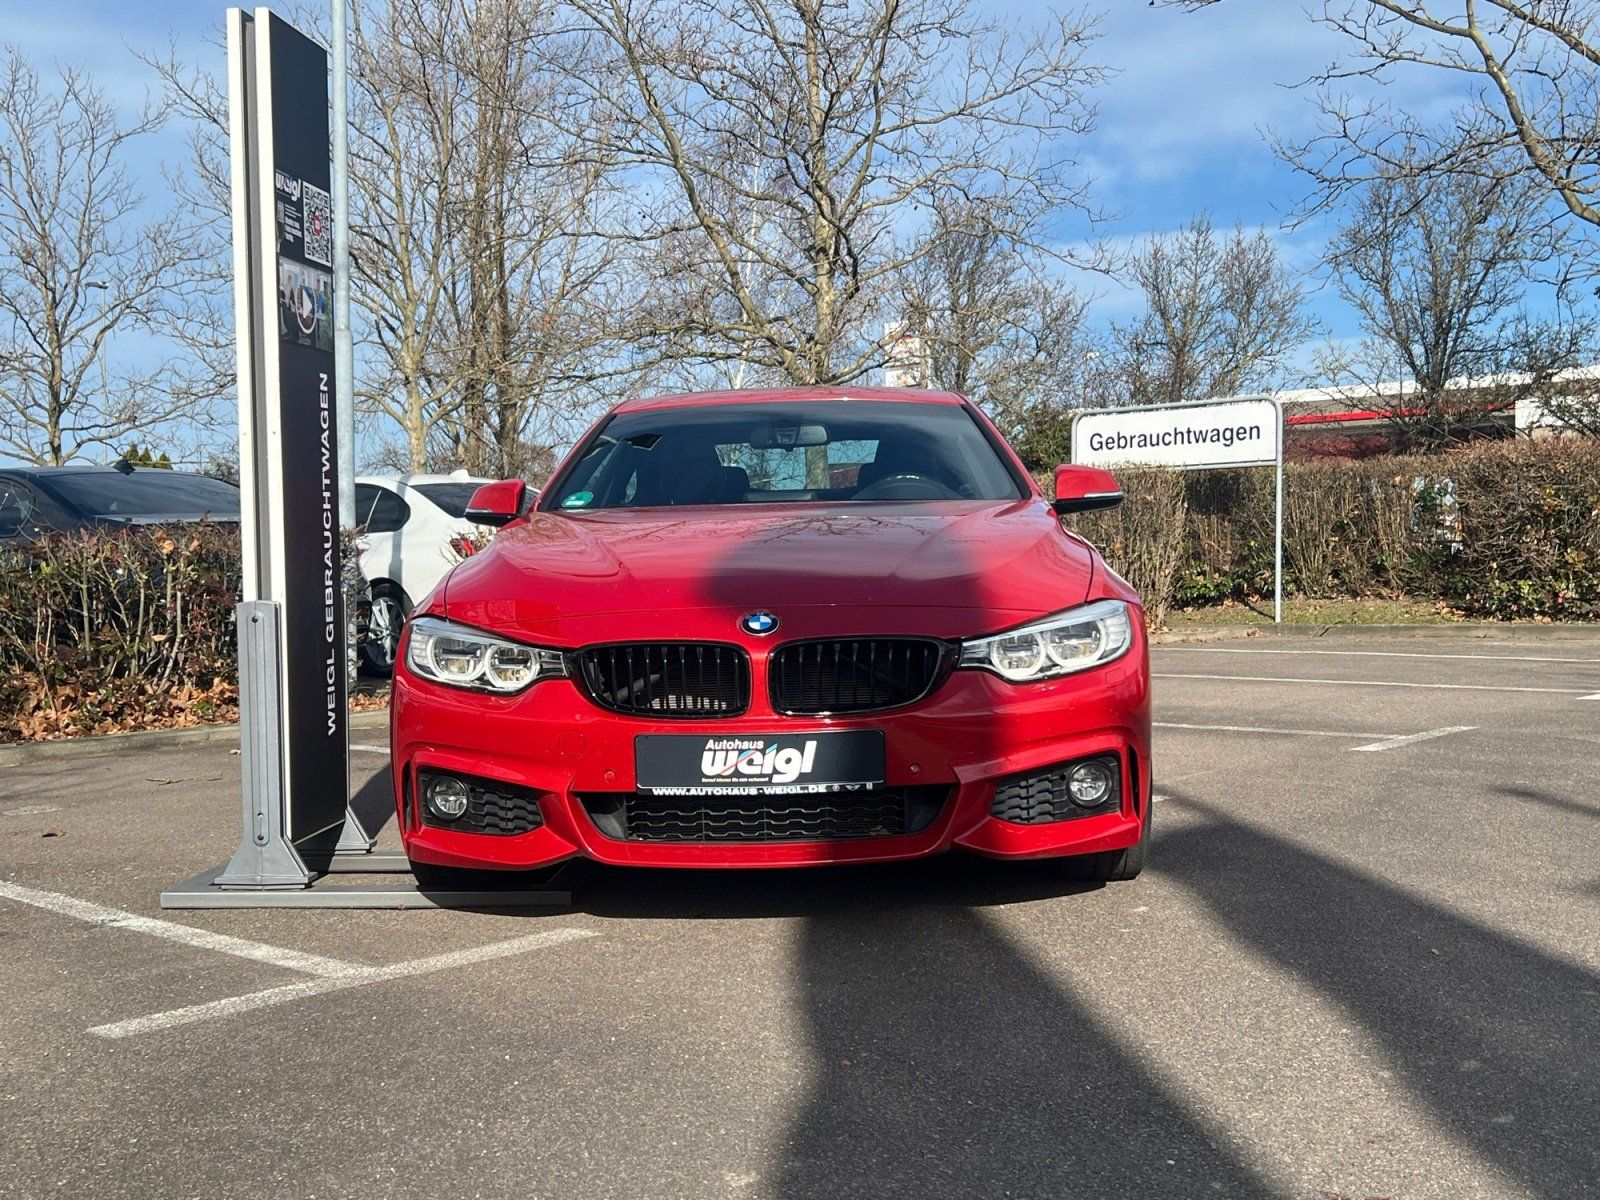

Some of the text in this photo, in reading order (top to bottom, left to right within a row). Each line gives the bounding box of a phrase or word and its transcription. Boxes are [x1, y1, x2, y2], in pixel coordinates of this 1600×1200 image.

[1090, 425, 1261, 452] Gebrauchtwagen
[319, 372, 336, 736] WEIGL GEBRAUCHTWAGEN
[705, 739, 764, 750] Autohaus
[700, 741, 817, 783] weigl
